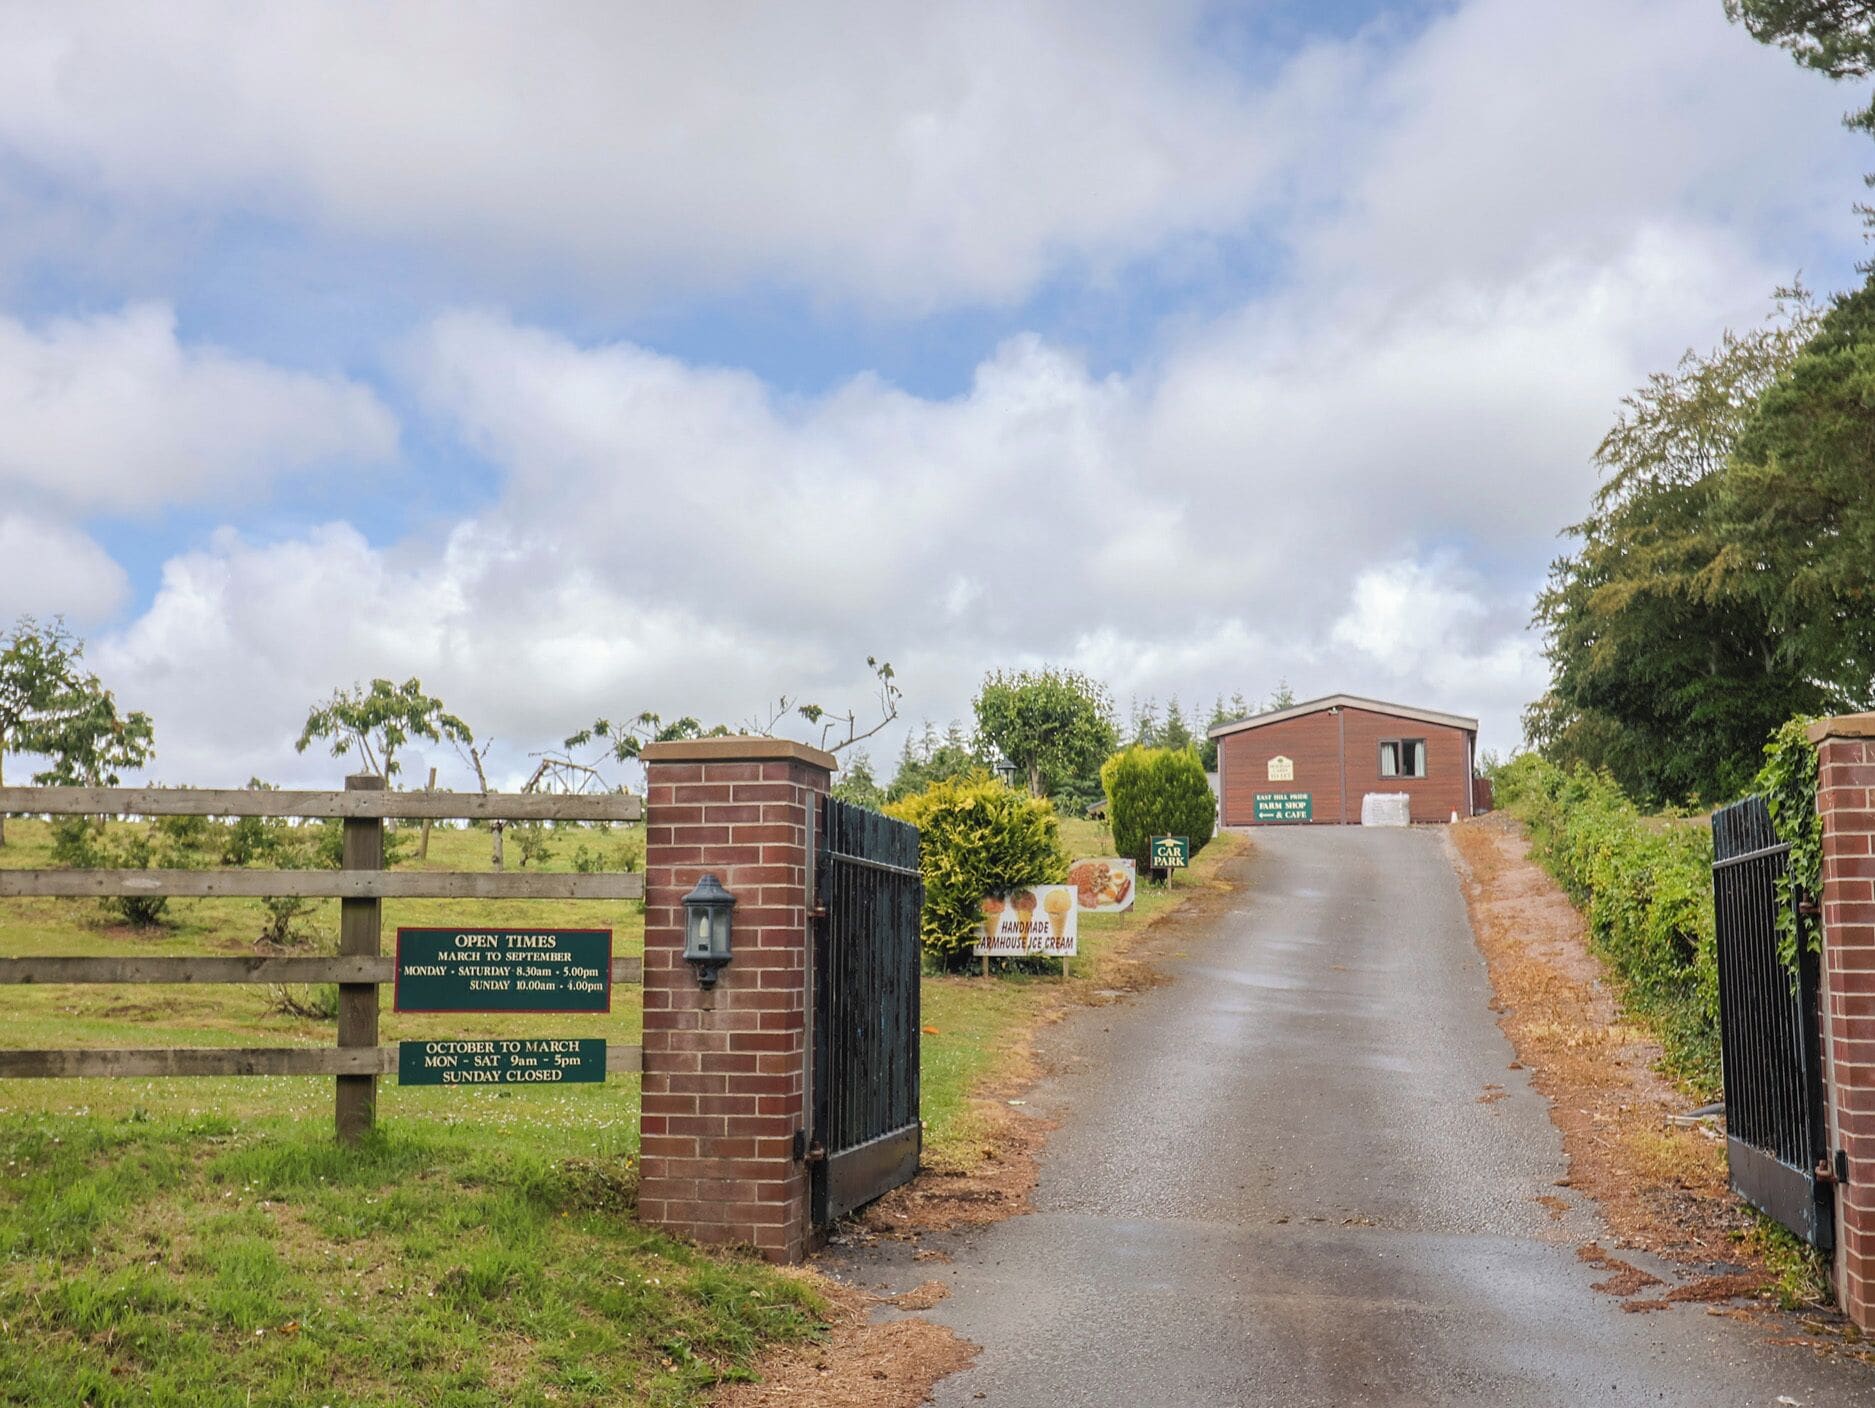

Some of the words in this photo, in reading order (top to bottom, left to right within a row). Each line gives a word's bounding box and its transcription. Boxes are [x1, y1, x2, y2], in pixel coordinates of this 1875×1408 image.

[1276, 811, 1283, 819] &
[1285, 811, 1307, 819] CAFE
[1157, 847, 1181, 856] CAR
[1154, 856, 1185, 866] PARK
[1001, 921, 1049, 934] HANDMADE
[454, 934, 499, 948] OPEN
[506, 935, 556, 948] TIMES
[1028, 936, 1042, 949] ICE
[1044, 936, 1074, 949] CREAM
[437, 951, 480, 961] MARCH
[485, 952, 501, 961] TO
[505, 952, 572, 962] SEPTEMBER
[404, 966, 447, 976] MONDAY
[458, 966, 511, 976] SATURDAY
[516, 966, 552, 976] 8.30am
[562, 966, 599, 979] 5.00pm
[469, 980, 510, 990] SUNDAY
[516, 980, 556, 991] 10.00am
[567, 980, 603, 993] 4.00pm
[426, 1042, 495, 1054] OCTOBER
[500, 1042, 521, 1053] TO
[525, 1041, 580, 1052] MARCH
[424, 1056, 458, 1068] MON
[474, 1056, 501, 1066] SAT
[510, 1055, 538, 1066] 9am
[554, 1055, 581, 1067] 5pm
[442, 1070, 501, 1083] SUNDAY
[506, 1069, 563, 1082] CLOSED
